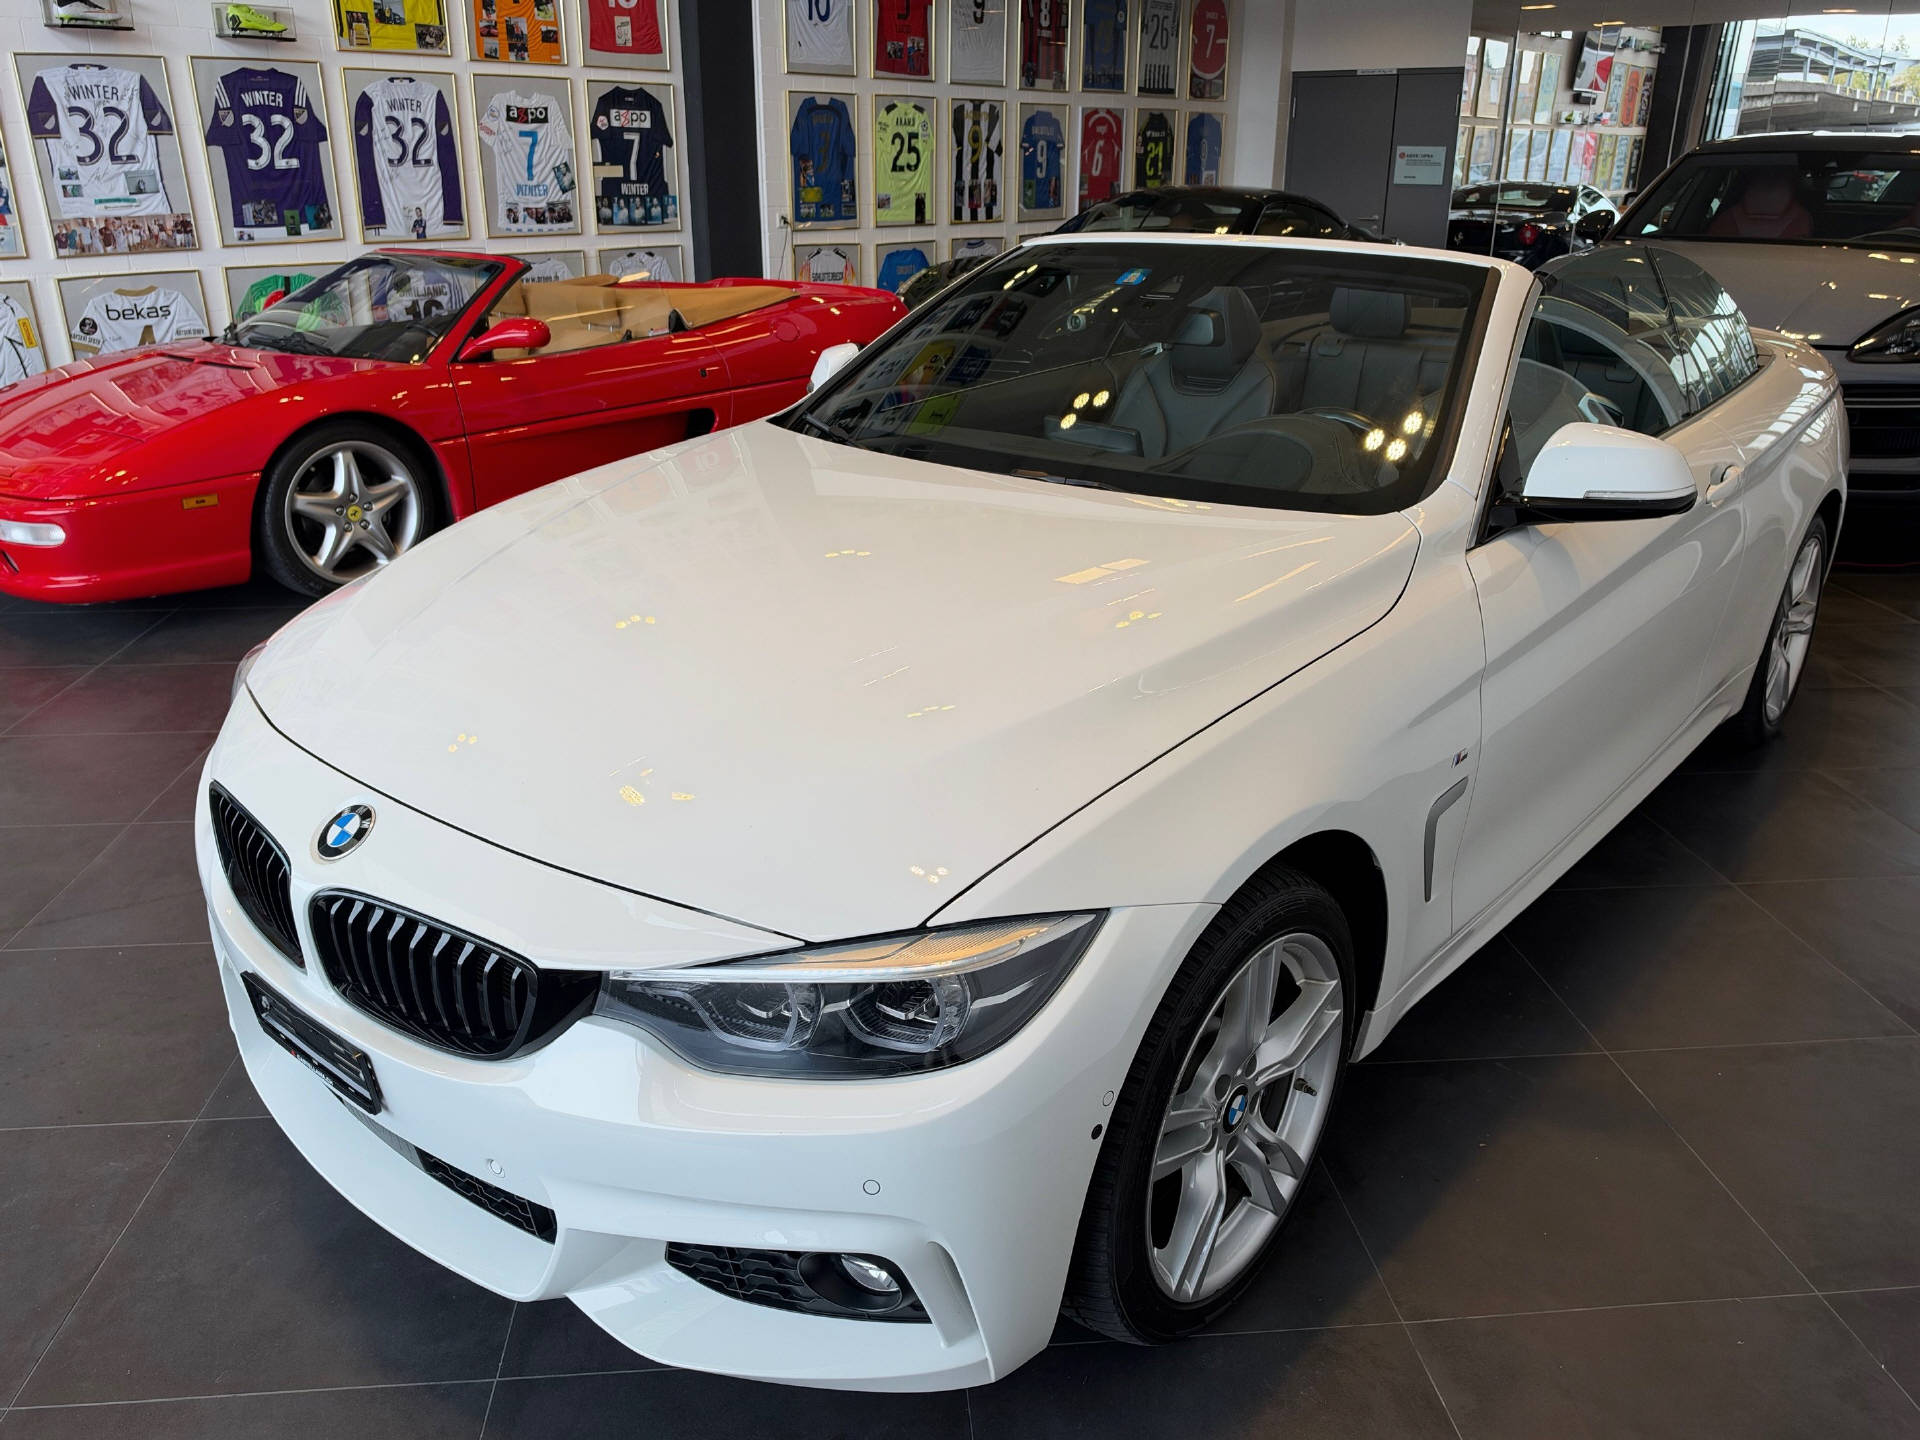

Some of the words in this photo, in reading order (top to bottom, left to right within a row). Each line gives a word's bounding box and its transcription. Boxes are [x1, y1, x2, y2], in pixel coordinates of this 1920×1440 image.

[1149, 15, 1168, 49] 26
[1206, 25, 1215, 58] 7
[67, 85, 120, 101] WINTER
[241, 91, 283, 108] WINTER
[387, 98, 422, 113] WINTER
[67, 107, 139, 166] 32
[242, 115, 300, 170] 32
[385, 116, 433, 167] 32
[891, 132, 920, 172] 25
[968, 125, 982, 165] 9
[519, 131, 538, 181] 7
[623, 132, 640, 181] 7
[1036, 140, 1047, 178] 9
[1092, 140, 1104, 176] 6
[516, 184, 548, 196] WINTER
[621, 183, 649, 195] WINTER
[105, 304, 171, 320] bekaş
